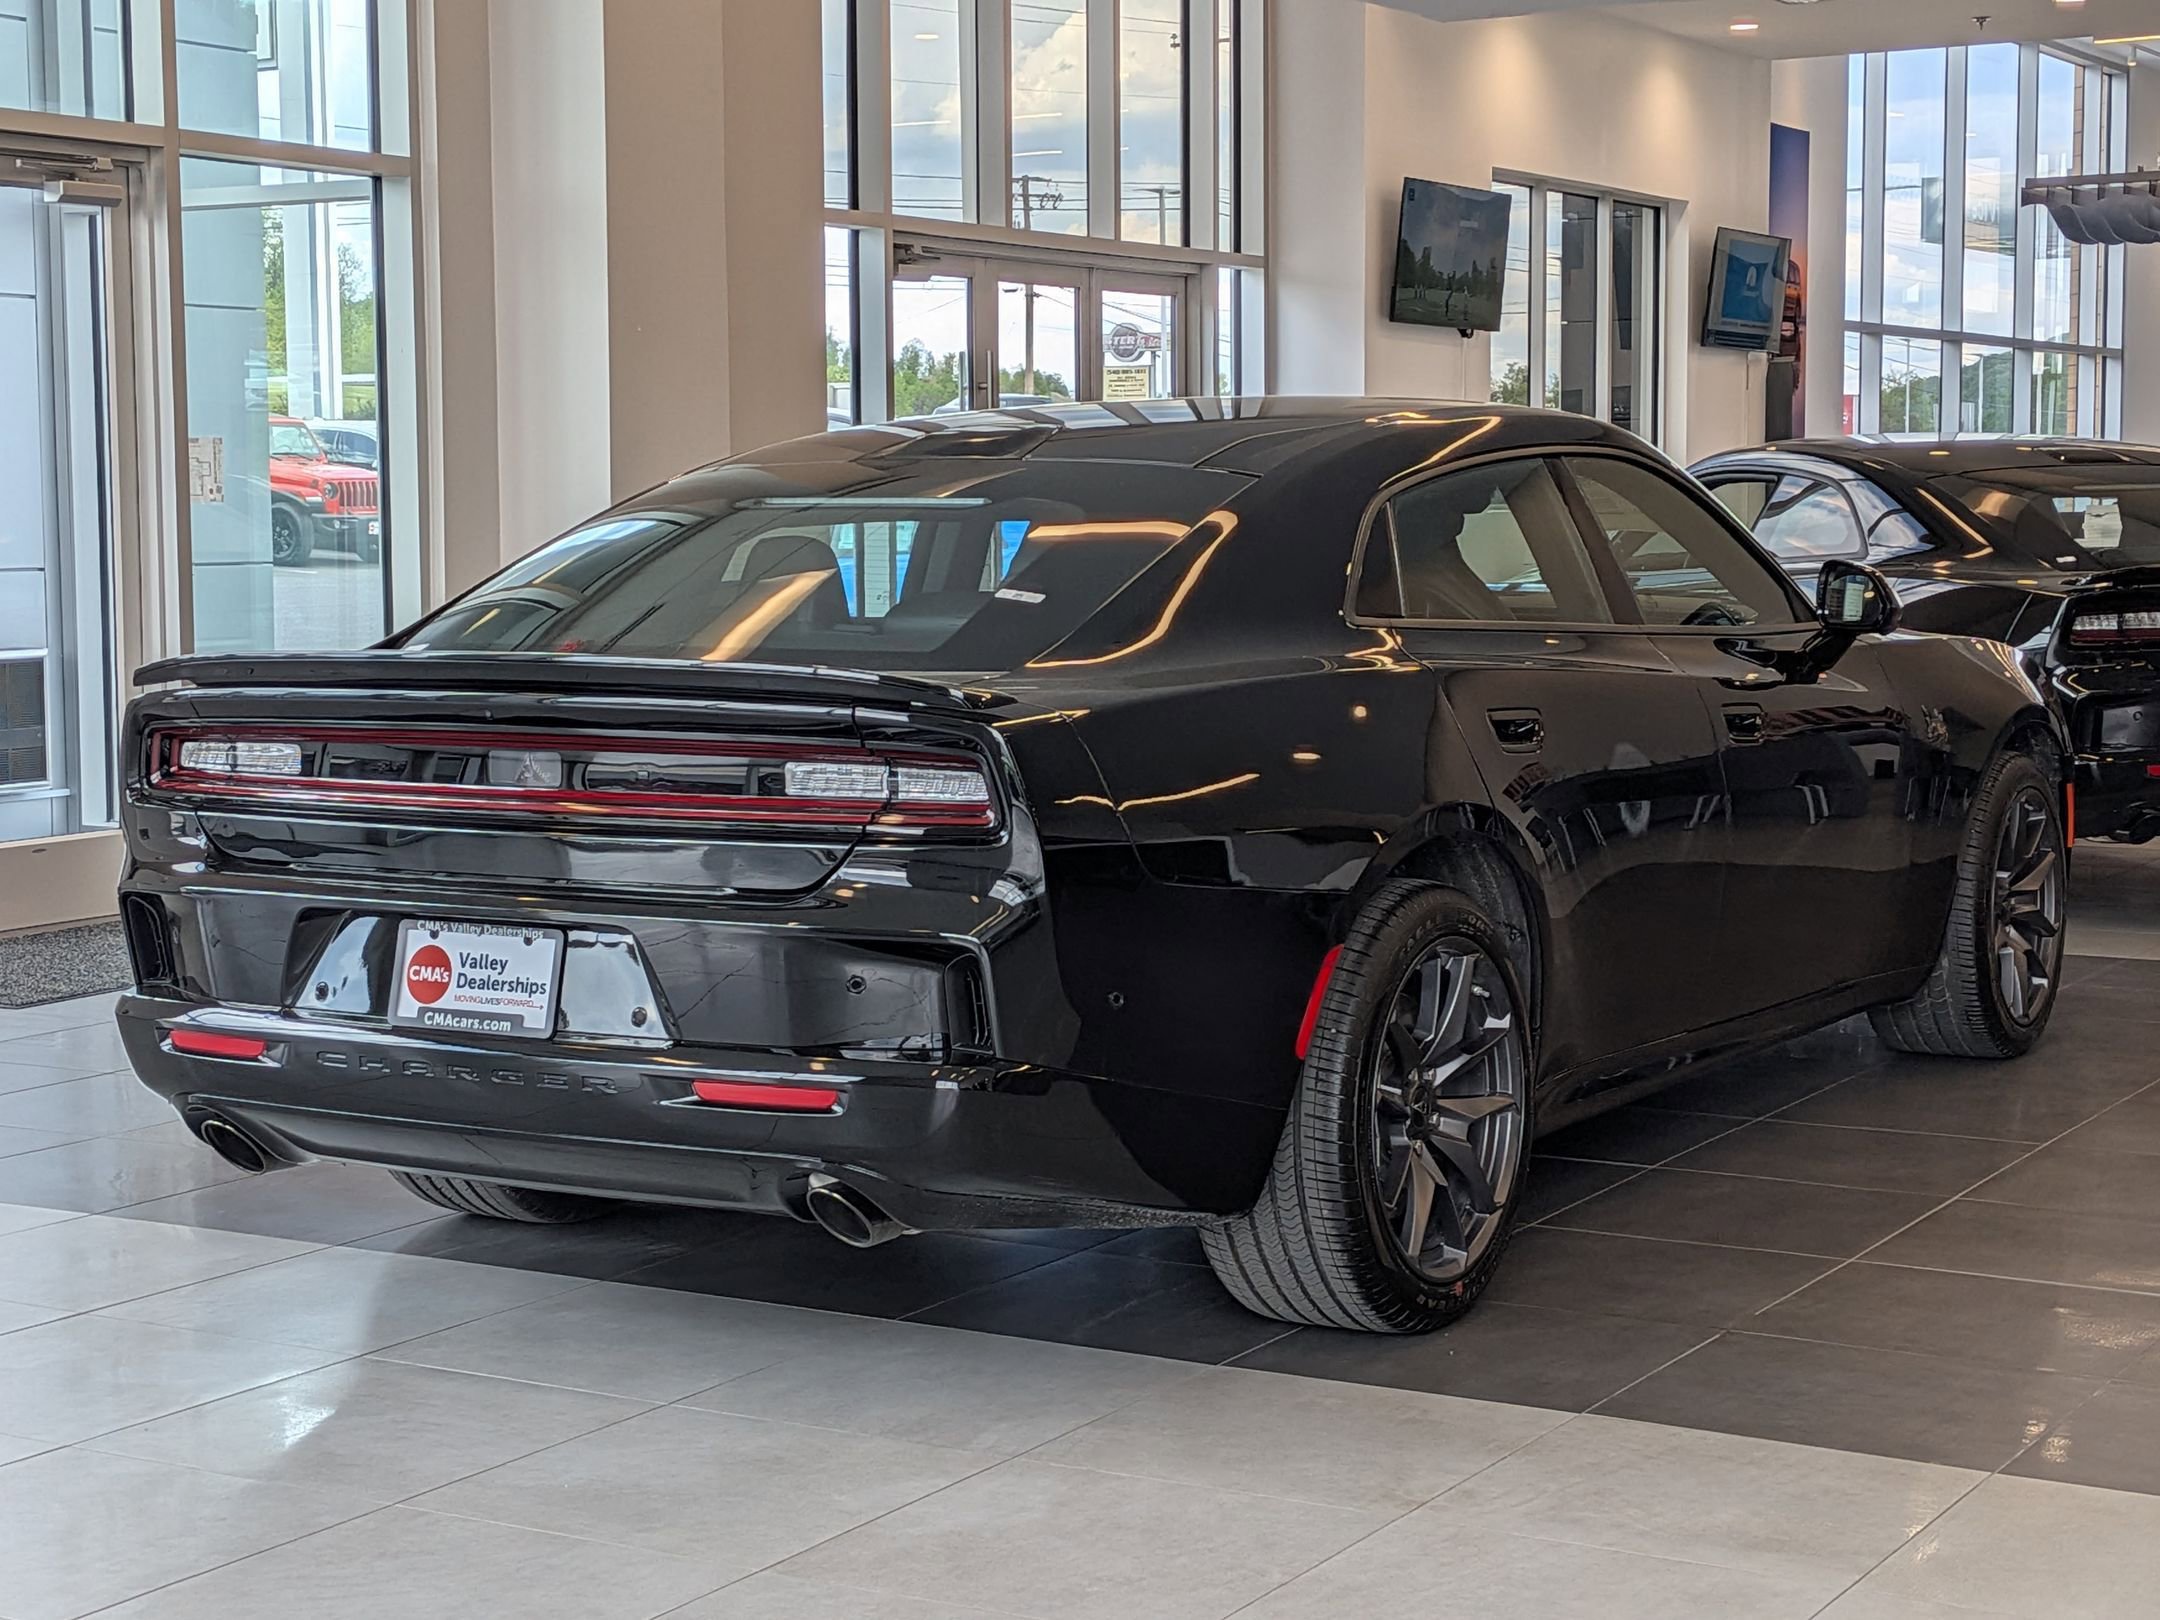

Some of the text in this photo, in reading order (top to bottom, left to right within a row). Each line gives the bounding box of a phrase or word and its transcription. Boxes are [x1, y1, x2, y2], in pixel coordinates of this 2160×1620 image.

[417, 920, 544, 940] CMA's Valley Dealerships
[409, 965, 450, 983] CMA's
[459, 952, 509, 975] Valley
[456, 973, 547, 997] Dealerships
[424, 1011, 512, 1032] CMAcars.com
[316, 1050, 619, 1094] CHARGER
